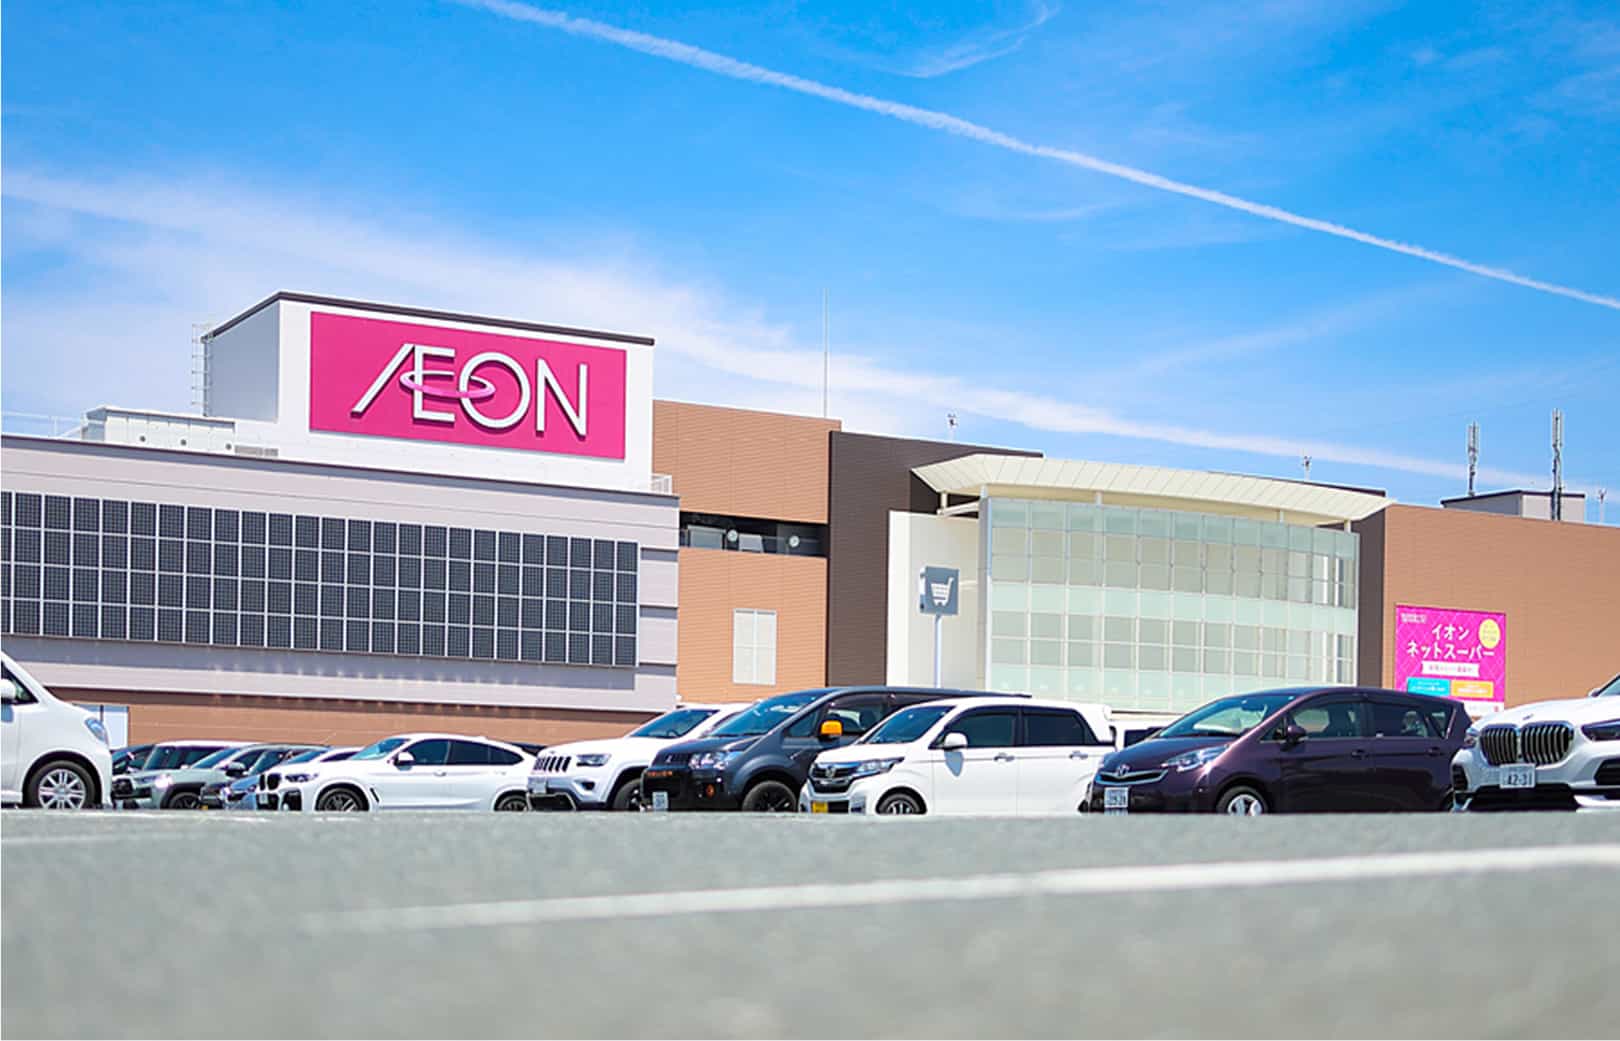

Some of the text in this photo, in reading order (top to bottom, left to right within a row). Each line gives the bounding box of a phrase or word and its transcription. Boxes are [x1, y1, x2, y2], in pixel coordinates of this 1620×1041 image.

[1431, 623, 1470, 641] イオン
[1406, 640, 1495, 660] ネットスーパー
